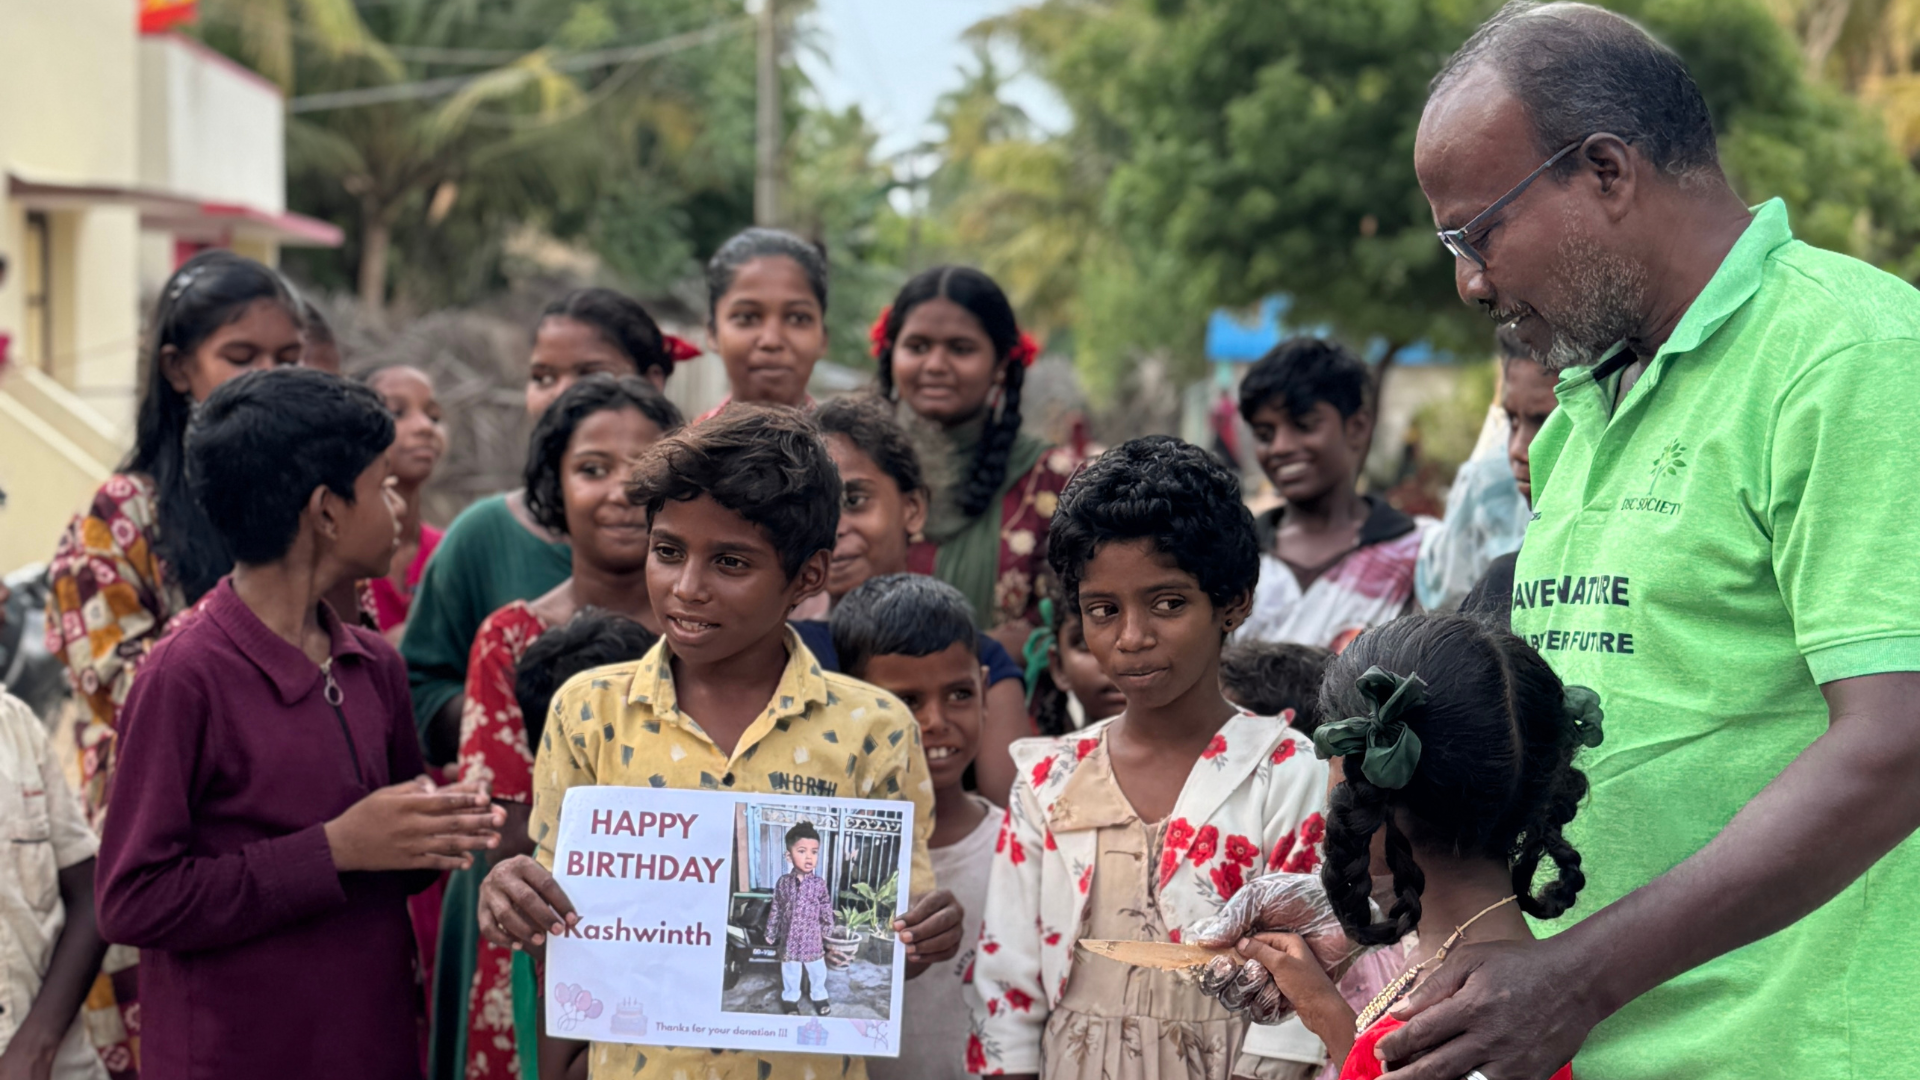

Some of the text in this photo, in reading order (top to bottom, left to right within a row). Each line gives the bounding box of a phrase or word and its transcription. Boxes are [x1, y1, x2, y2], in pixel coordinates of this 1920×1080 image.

[1513, 579, 1556, 610] AVE
[1570, 631, 1634, 654] FUTRE
[779, 771, 837, 797] NORTH
[591, 809, 699, 839] HAPPY
[566, 850, 726, 884] BIRTHDAY
[564, 915, 712, 946] Kashwinth
[656, 1022, 689, 1032] Thanks
[692, 1023, 706, 1033] for
[708, 1027, 731, 1036] your
[733, 1026, 776, 1037] donation
